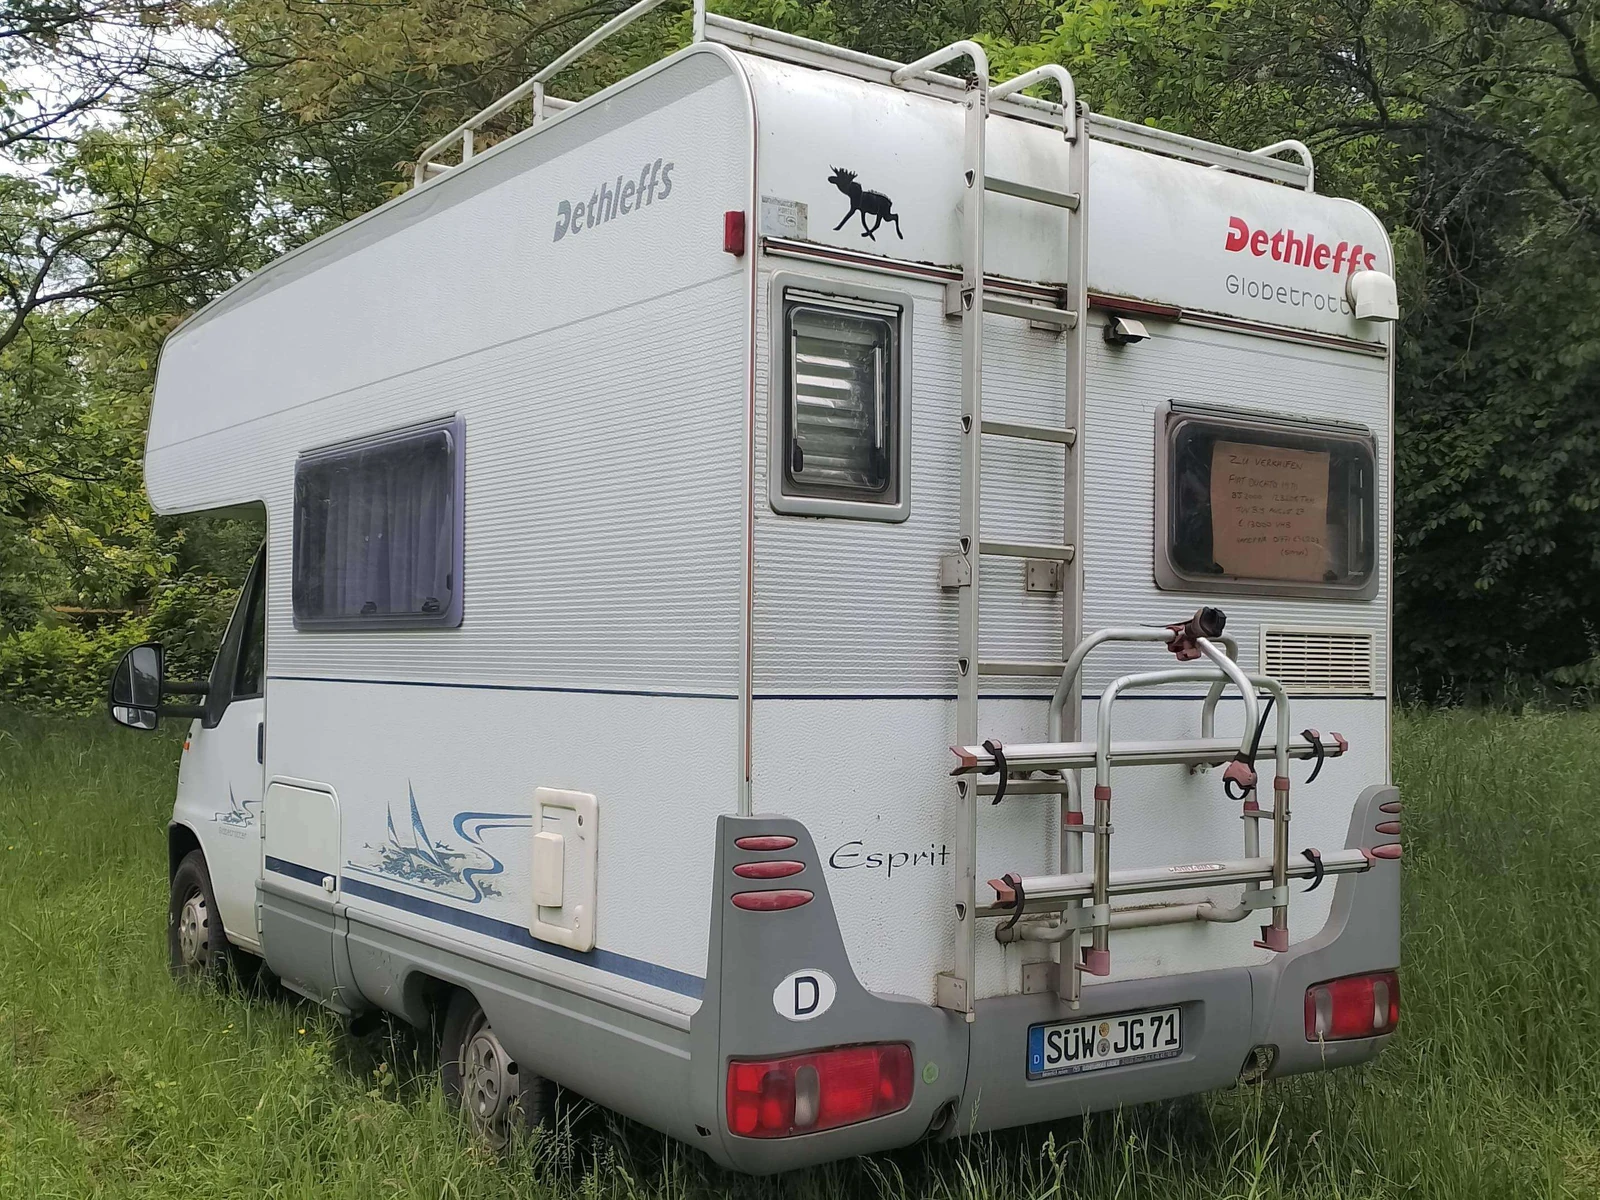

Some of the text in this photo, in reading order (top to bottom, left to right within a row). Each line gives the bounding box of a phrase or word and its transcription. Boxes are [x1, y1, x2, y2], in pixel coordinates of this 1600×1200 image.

[552, 157, 675, 243] Dethleffs
[1224, 215, 1377, 276] Dethleffs
[1225, 274, 1351, 316] Globetrott
[1228, 454, 1303, 470] ZU VERKAUFEN
[1228, 474, 1247, 485] FIAT
[1249, 477, 1278, 489] DUCATO
[828, 840, 951, 878] Esprit
[794, 975, 820, 1016] D
[1046, 1025, 1097, 1065] SÜW
[1113, 1018, 1145, 1054] JG
[1149, 1013, 1178, 1048] 71
